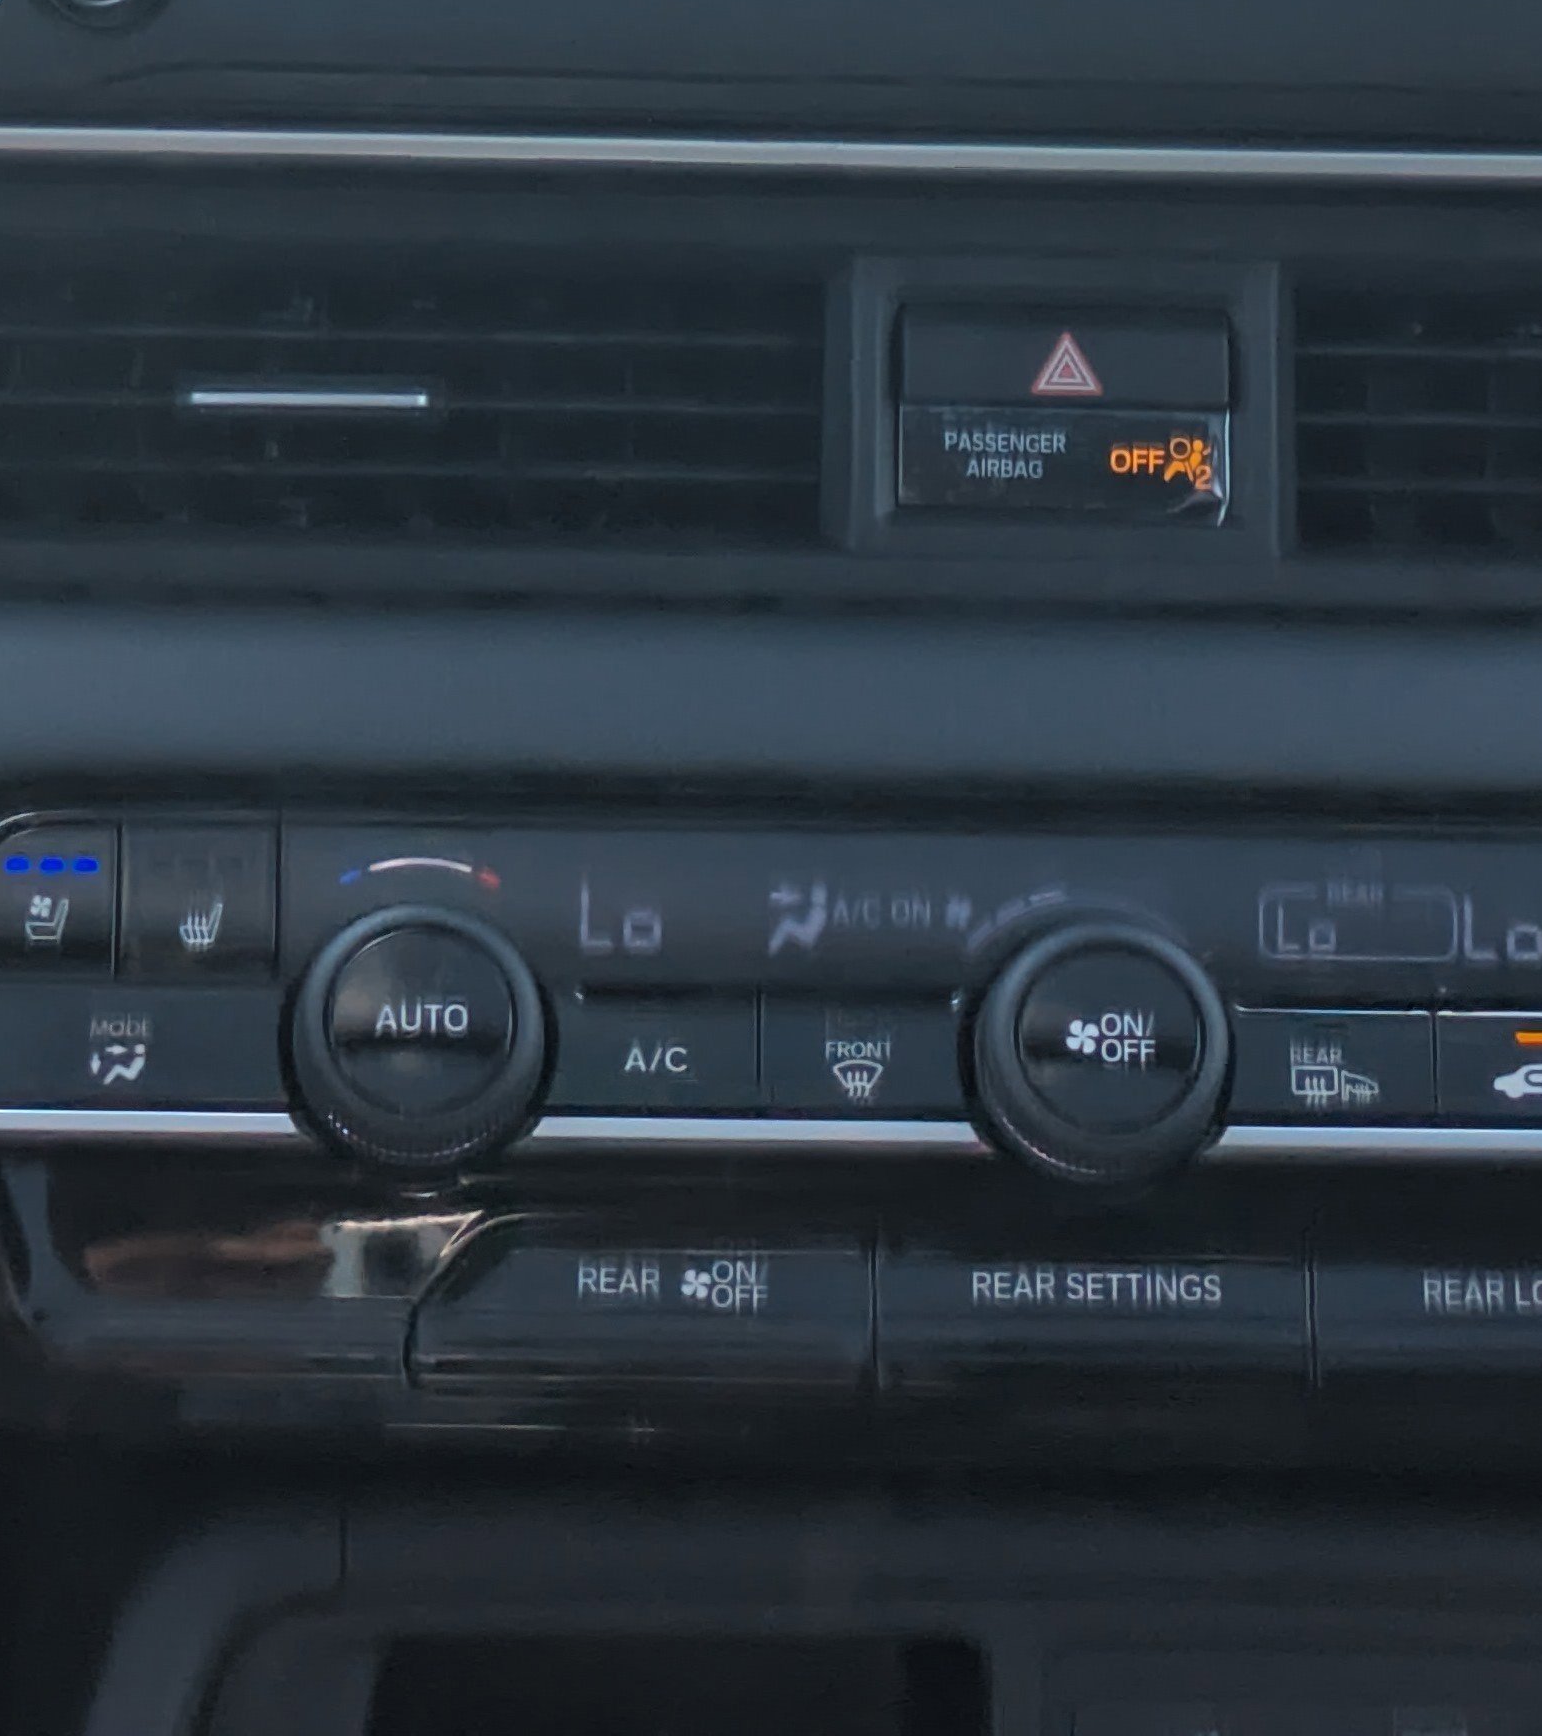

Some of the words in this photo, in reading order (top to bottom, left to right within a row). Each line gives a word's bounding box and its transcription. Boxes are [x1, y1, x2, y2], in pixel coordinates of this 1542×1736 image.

[944, 430, 1066, 454] PASSENGER
[967, 459, 1043, 479] AIRBAG
[1110, 448, 1164, 474] OFF
[375, 1004, 468, 1036] AUTO
[625, 1047, 688, 1073] A/C
[826, 1041, 891, 1060] FRONT
[1101, 1040, 1155, 1065] OFF
[1290, 1045, 1343, 1064] REAR
[577, 1266, 659, 1295] REAR
[972, 1270, 1055, 1302] REAR
[1067, 1271, 1221, 1303] SETTINGS
[1423, 1273, 1503, 1308] REAR
[712, 1284, 768, 1310] OFF
